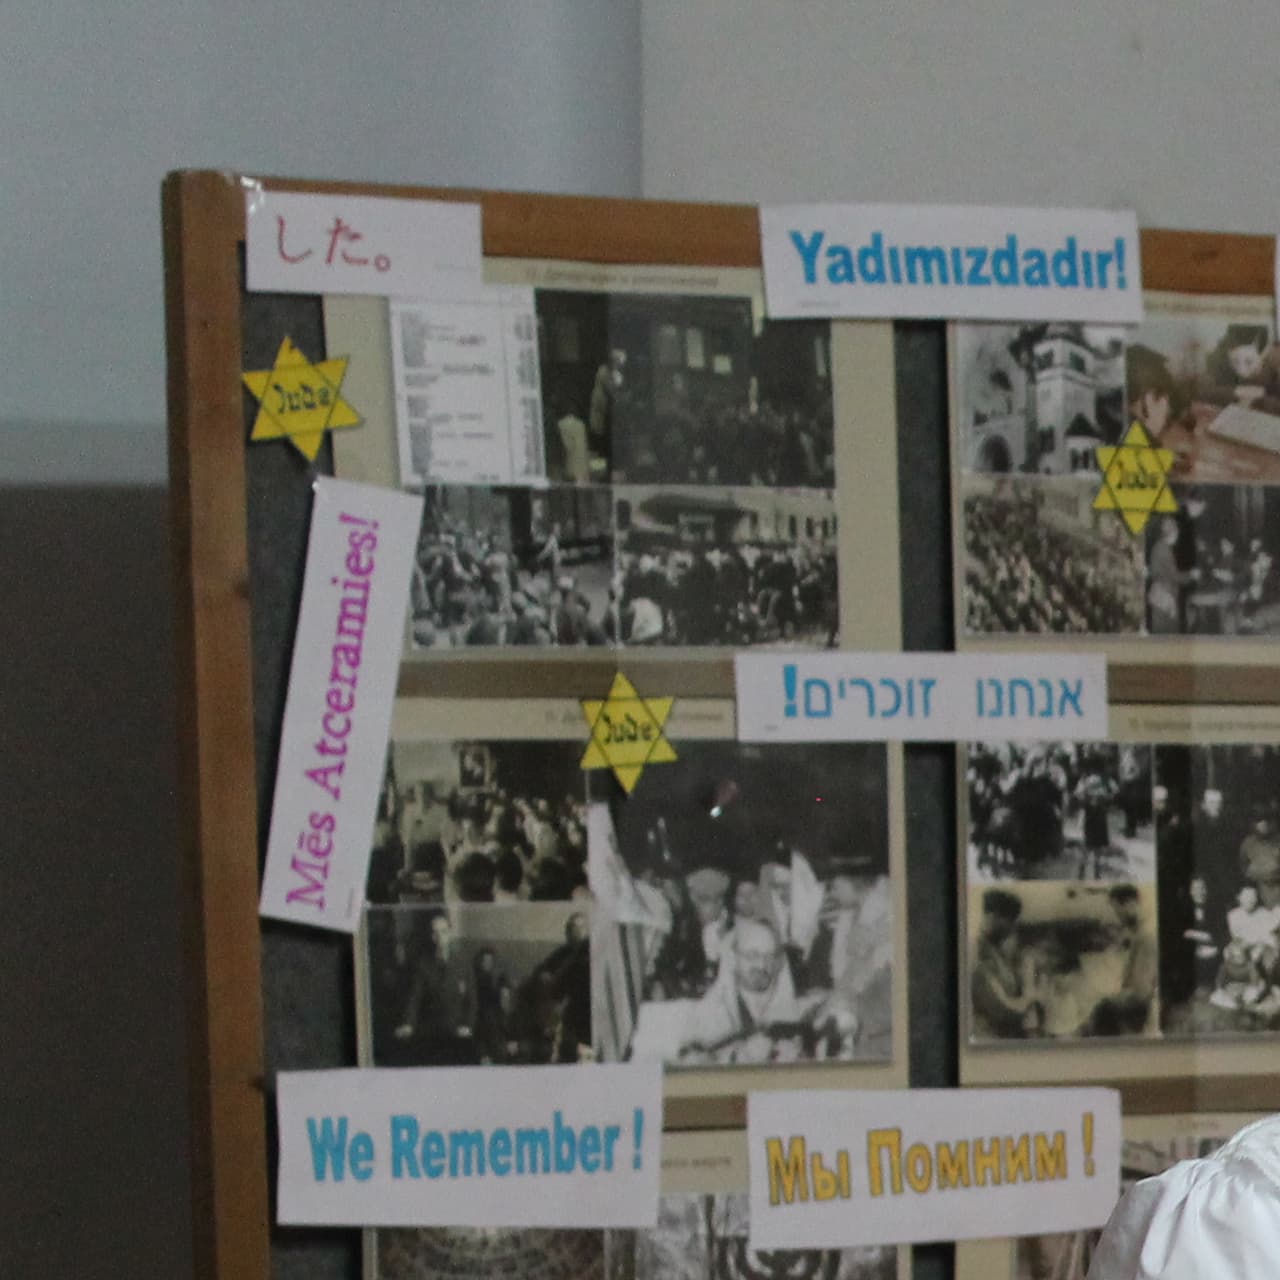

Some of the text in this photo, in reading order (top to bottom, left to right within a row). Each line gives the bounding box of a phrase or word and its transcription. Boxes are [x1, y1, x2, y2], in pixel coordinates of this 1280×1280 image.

[278, 217, 391, 272] した。
[285, 513, 379, 911] Mēs Atceramies!
[783, 663, 1083, 719] אנחנו זוכרים!
[306, 1117, 375, 1182] We
[390, 1111, 621, 1180] Remember
[767, 1137, 850, 1205] Мы
[868, 1129, 1067, 1196] Помним
